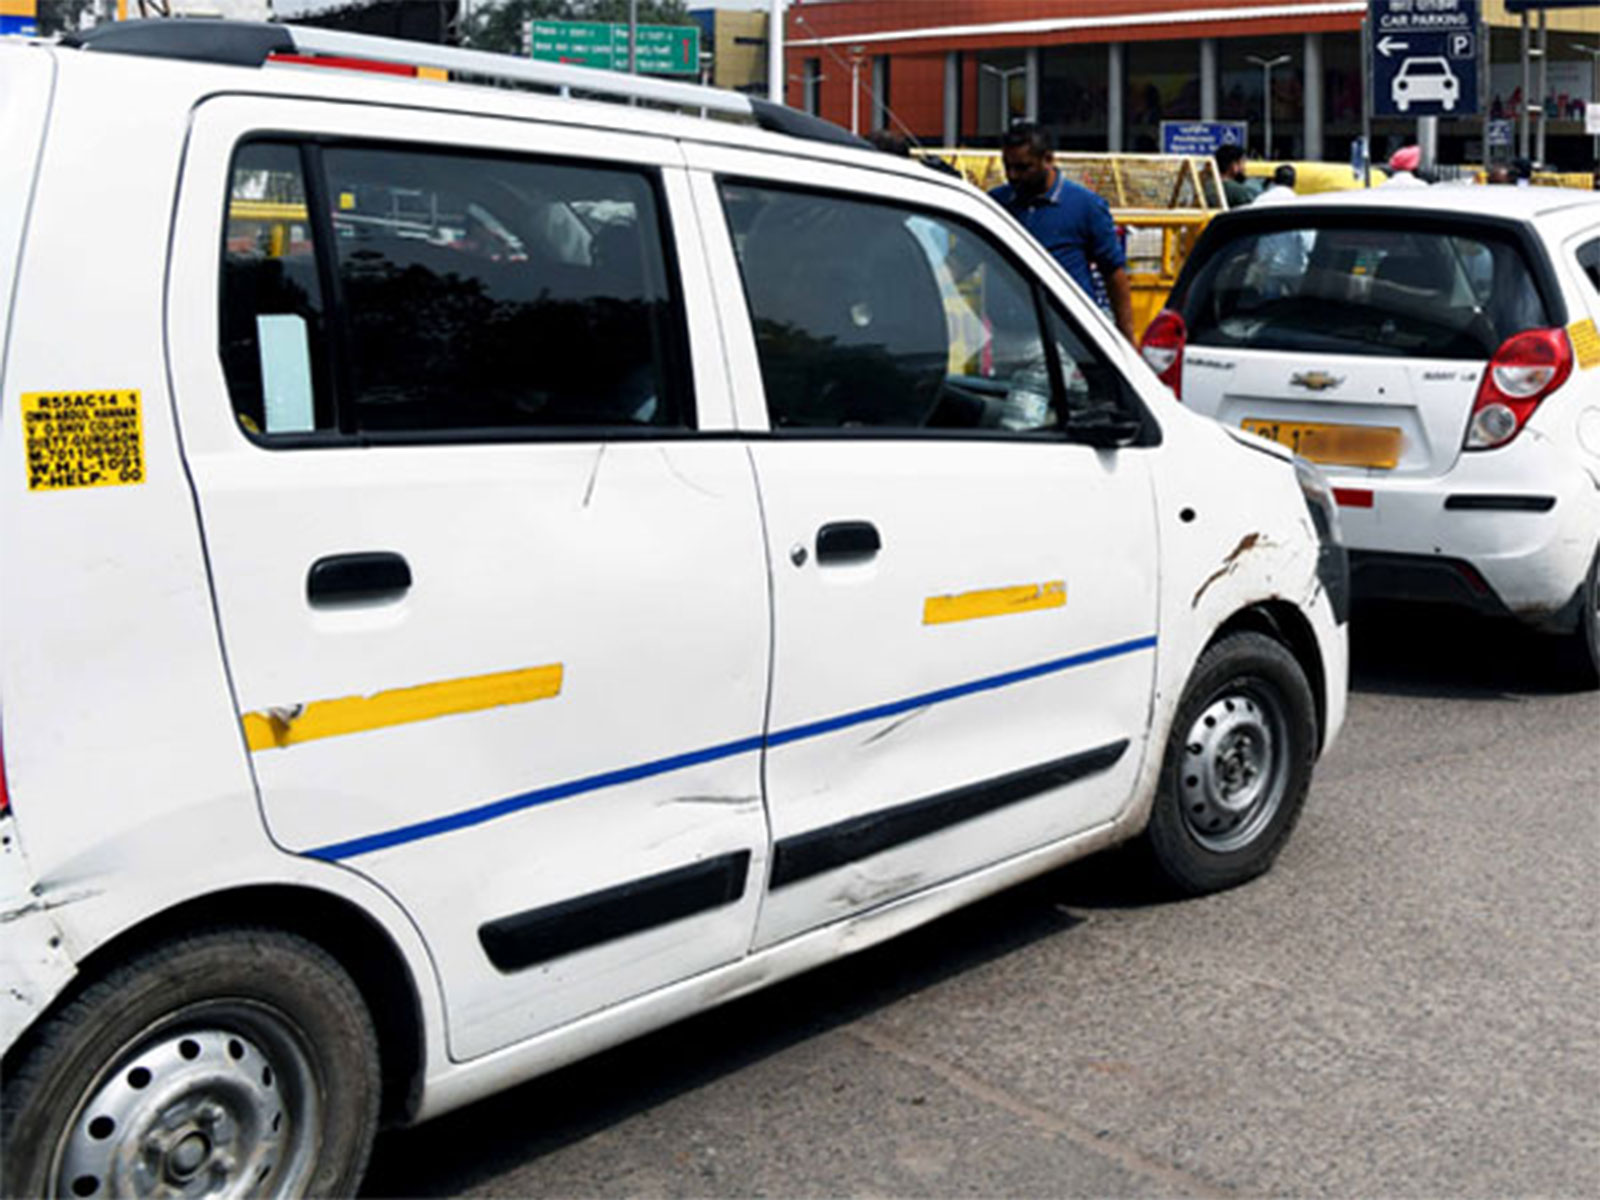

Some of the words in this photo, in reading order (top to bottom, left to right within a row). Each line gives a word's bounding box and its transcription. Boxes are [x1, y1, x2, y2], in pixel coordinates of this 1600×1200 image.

[1380, 14, 1408, 27] CAR
[1411, 12, 1468, 25] PARKING
[1453, 36, 1468, 55] P
